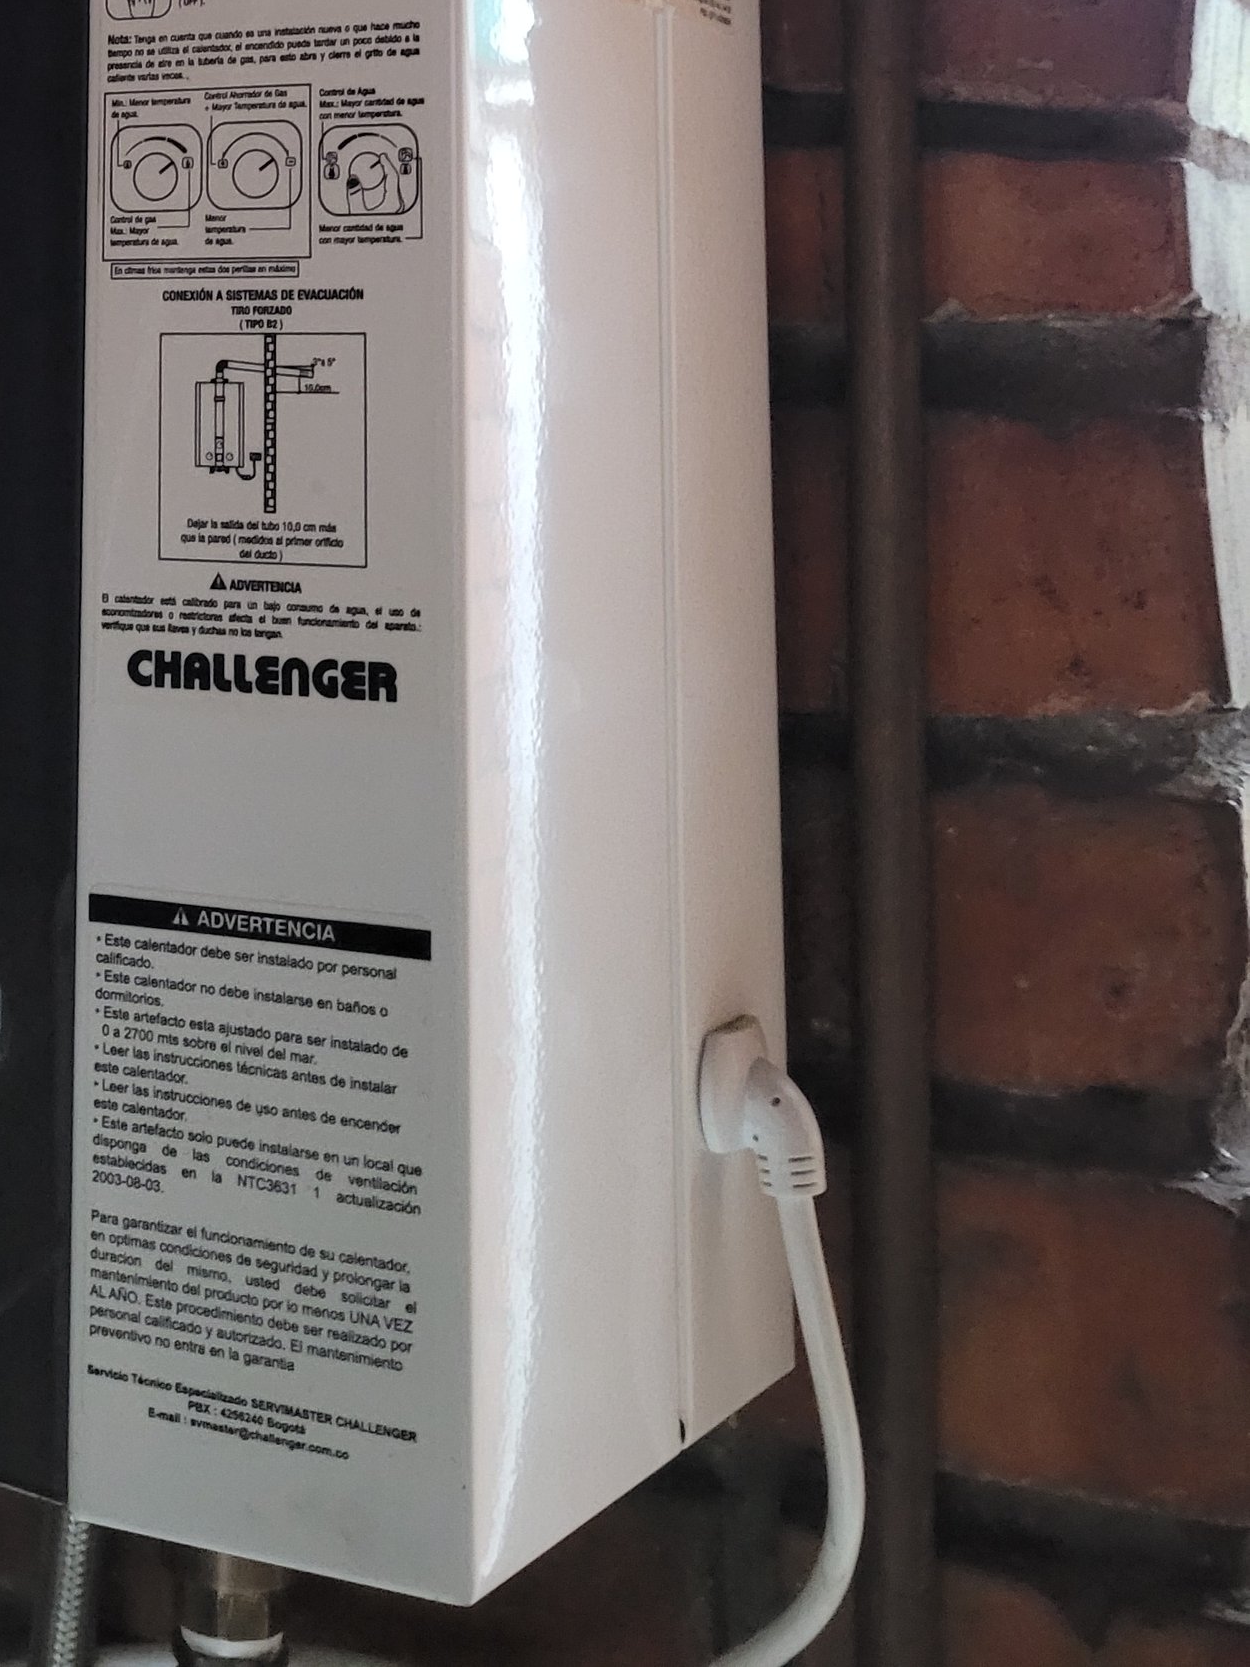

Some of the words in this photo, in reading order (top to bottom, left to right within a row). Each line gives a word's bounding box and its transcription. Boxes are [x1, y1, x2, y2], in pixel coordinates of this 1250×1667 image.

[162, 290, 212, 300] CONEXIÓN
[215, 290, 223, 300] A
[225, 289, 277, 299] SISTEMAS
[280, 289, 294, 299] DE
[297, 289, 363, 299] EVACUACIÓN
[231, 305, 250, 315] TIRO
[252, 304, 292, 314] FORZADO
[229, 579, 301, 593] ADVERTENCIA
[127, 649, 398, 702] CHALLENGER
[197, 909, 336, 942] ADVERTENCIA
[105, 933, 131, 948] Este
[134, 936, 197, 956] calentador
[200, 944, 231, 959] debe
[234, 951, 254, 962] ser
[257, 950, 313, 969] instalado
[317, 961, 338, 975] por
[341, 960, 397, 982] personal
[95, 986, 163, 1006] dormitorios.
[104, 968, 130, 984] Este
[134, 972, 196, 992] calentador
[200, 984, 215, 995] no
[218, 983, 249, 999] debe
[253, 987, 313, 1007] instalarse
[316, 999, 332, 1009] en
[336, 998, 376, 1015] baños
[379, 1007, 388, 1016] o
[103, 1005, 129, 1020] Este
[133, 1009, 185, 1028] artefacto
[218, 1020, 271, 1042] ajustado
[274, 1031, 302, 1046] para
[307, 1035, 327, 1046] ser
[330, 1034, 388, 1054] instalado
[391, 1042, 408, 1057] de
[113, 1028, 120, 1037] a
[124, 1025, 153, 1042] 2700
[157, 1030, 179, 1045] mts
[182, 1033, 216, 1050] sobre
[220, 1038, 231, 1052] el
[235, 1040, 263, 1056] nivel
[267, 1045, 286, 1060] del
[94, 1059, 119, 1074] este
[122, 1063, 187, 1083] calentador.
[103, 1040, 129, 1056] Leer
[132, 1044, 149, 1059] las
[153, 1047, 232, 1071] instrucciones
[236, 1059, 287, 1078] técnicas
[291, 1067, 326, 1084] antes
[329, 1072, 346, 1086] de
[350, 1075, 397, 1094] instalar
[93, 1095, 118, 1110] este
[122, 1098, 187, 1120] calentador.
[102, 1077, 128, 1093] Leer
[132, 1081, 149, 1096] las
[153, 1084, 232, 1108] instrucciones
[235, 1096, 251, 1111] de
[255, 1103, 278, 1114] uso
[282, 1103, 316, 1120] antes
[320, 1108, 336, 1123] de
[340, 1111, 400, 1132] encender
[92, 1132, 146, 1155] disponga
[161, 1142, 177, 1157] de
[192, 1147, 209, 1162] las
[225, 1152, 299, 1175] condiciones
[315, 1165, 332, 1180] de
[347, 1170, 417, 1194] ventilación
[101, 1113, 127, 1129] Este
[131, 1118, 184, 1138] artefacto
[217, 1131, 255, 1152] puede
[259, 1137, 319, 1159] instalarse
[323, 1151, 339, 1162] en
[343, 1154, 359, 1165] un
[363, 1153, 393, 1170] local
[397, 1162, 422, 1178] que
[91, 1208, 118, 1225] Para
[122, 1213, 182, 1238] garantizar
[186, 1223, 197, 1237] el
[200, 1226, 295, 1253] funcionamiento
[299, 1241, 315, 1256] de
[319, 1248, 335, 1259] su
